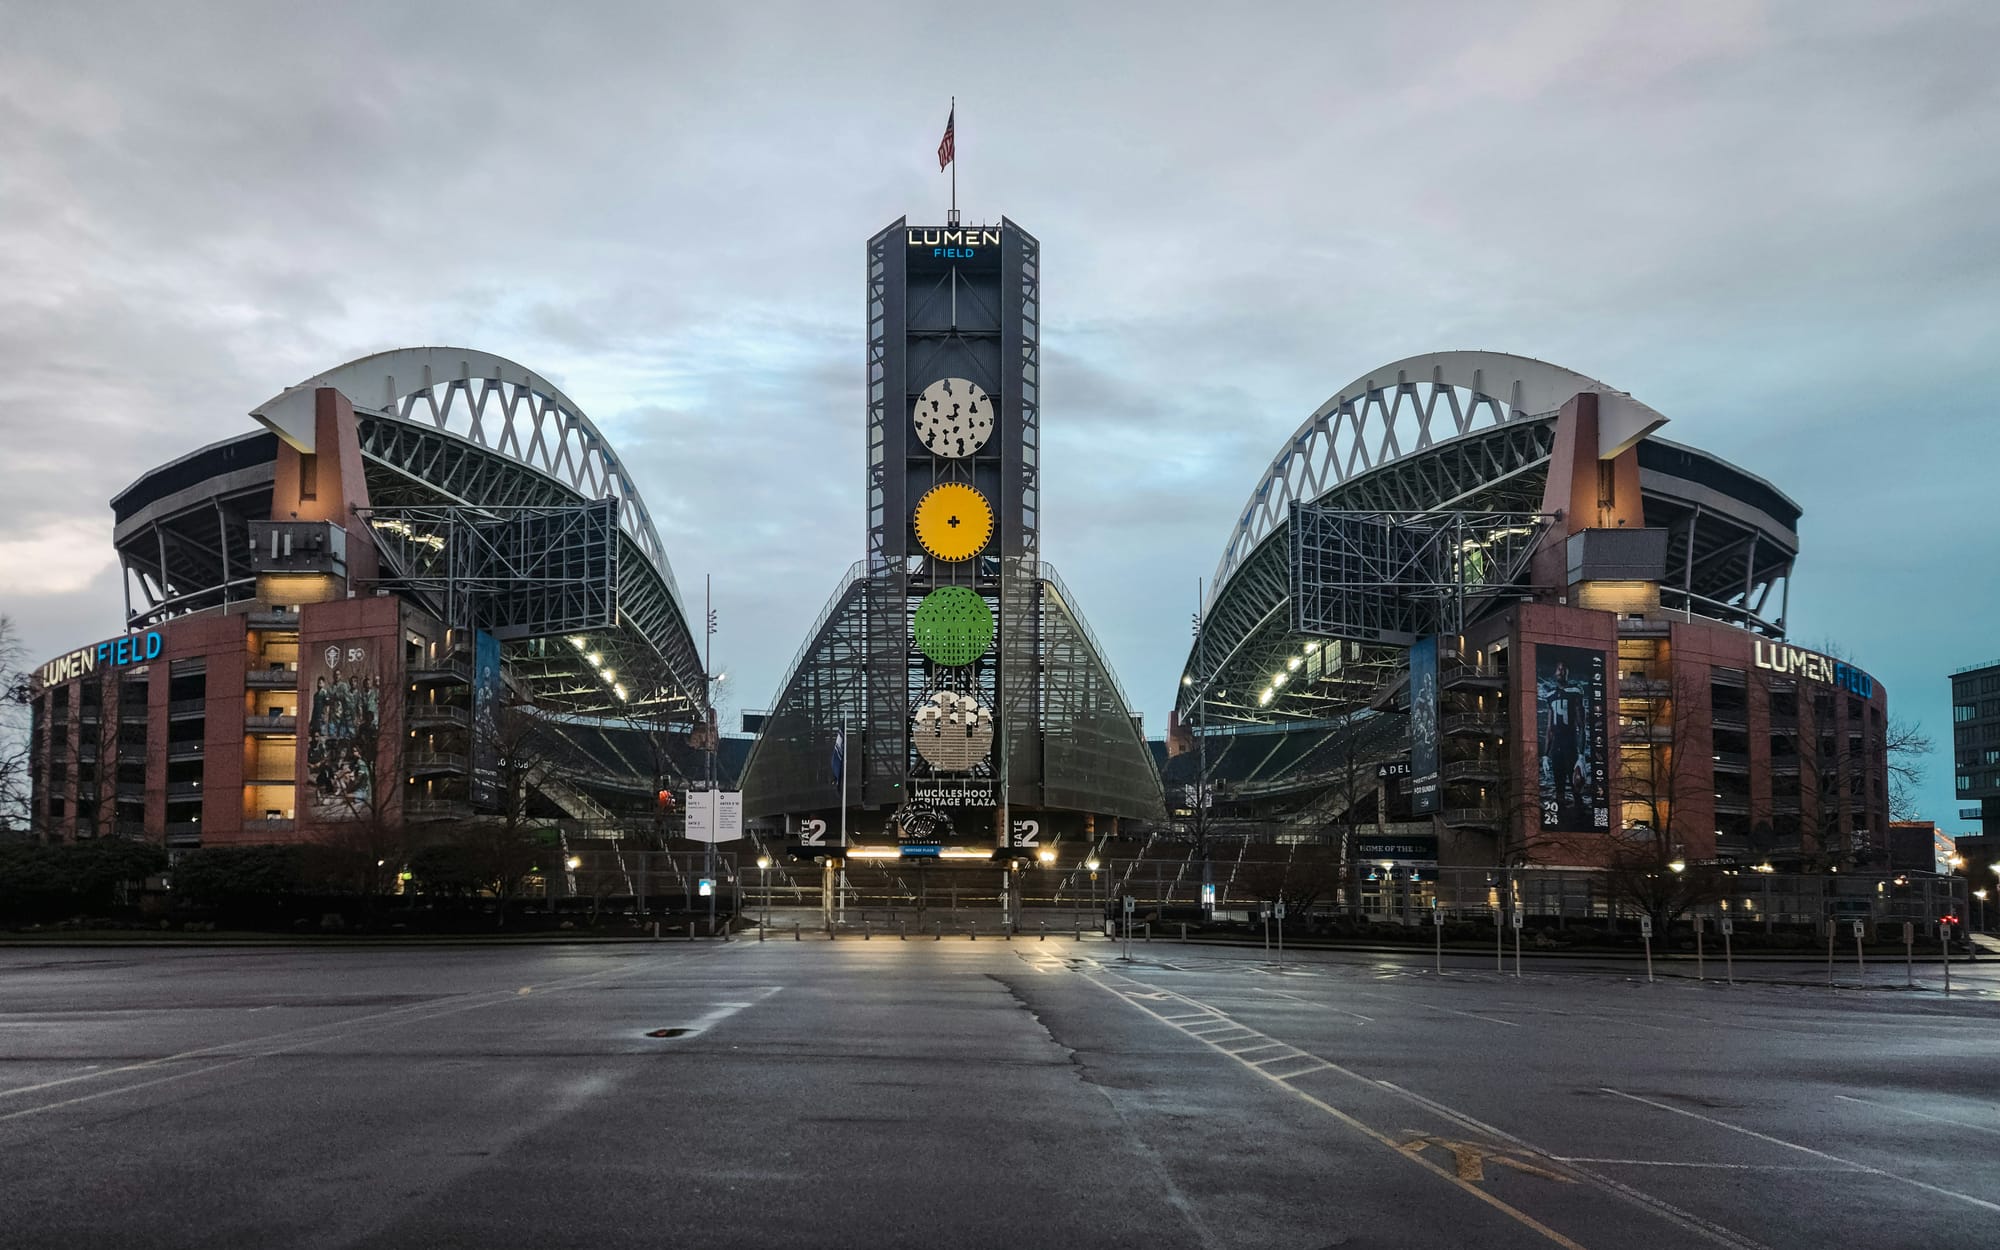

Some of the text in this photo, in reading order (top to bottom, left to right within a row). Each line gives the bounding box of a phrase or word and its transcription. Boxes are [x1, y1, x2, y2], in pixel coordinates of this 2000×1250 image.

[908, 230, 1000, 245] LUMEN
[934, 248, 974, 258] FIELD
[43, 631, 162, 688] LUMEN FIELD
[1754, 640, 1873, 699] LUMEN FIELD
[1551, 699, 1569, 725] 14
[915, 789, 993, 798] MUCKLESHOOT
[965, 798, 997, 807] PLAZA
[1543, 801, 1558, 812] 20
[1544, 813, 1559, 825] 24
[801, 819, 827, 846] GATE 2
[1013, 820, 1039, 847] GATE 2
[1397, 845, 1413, 853] THE
